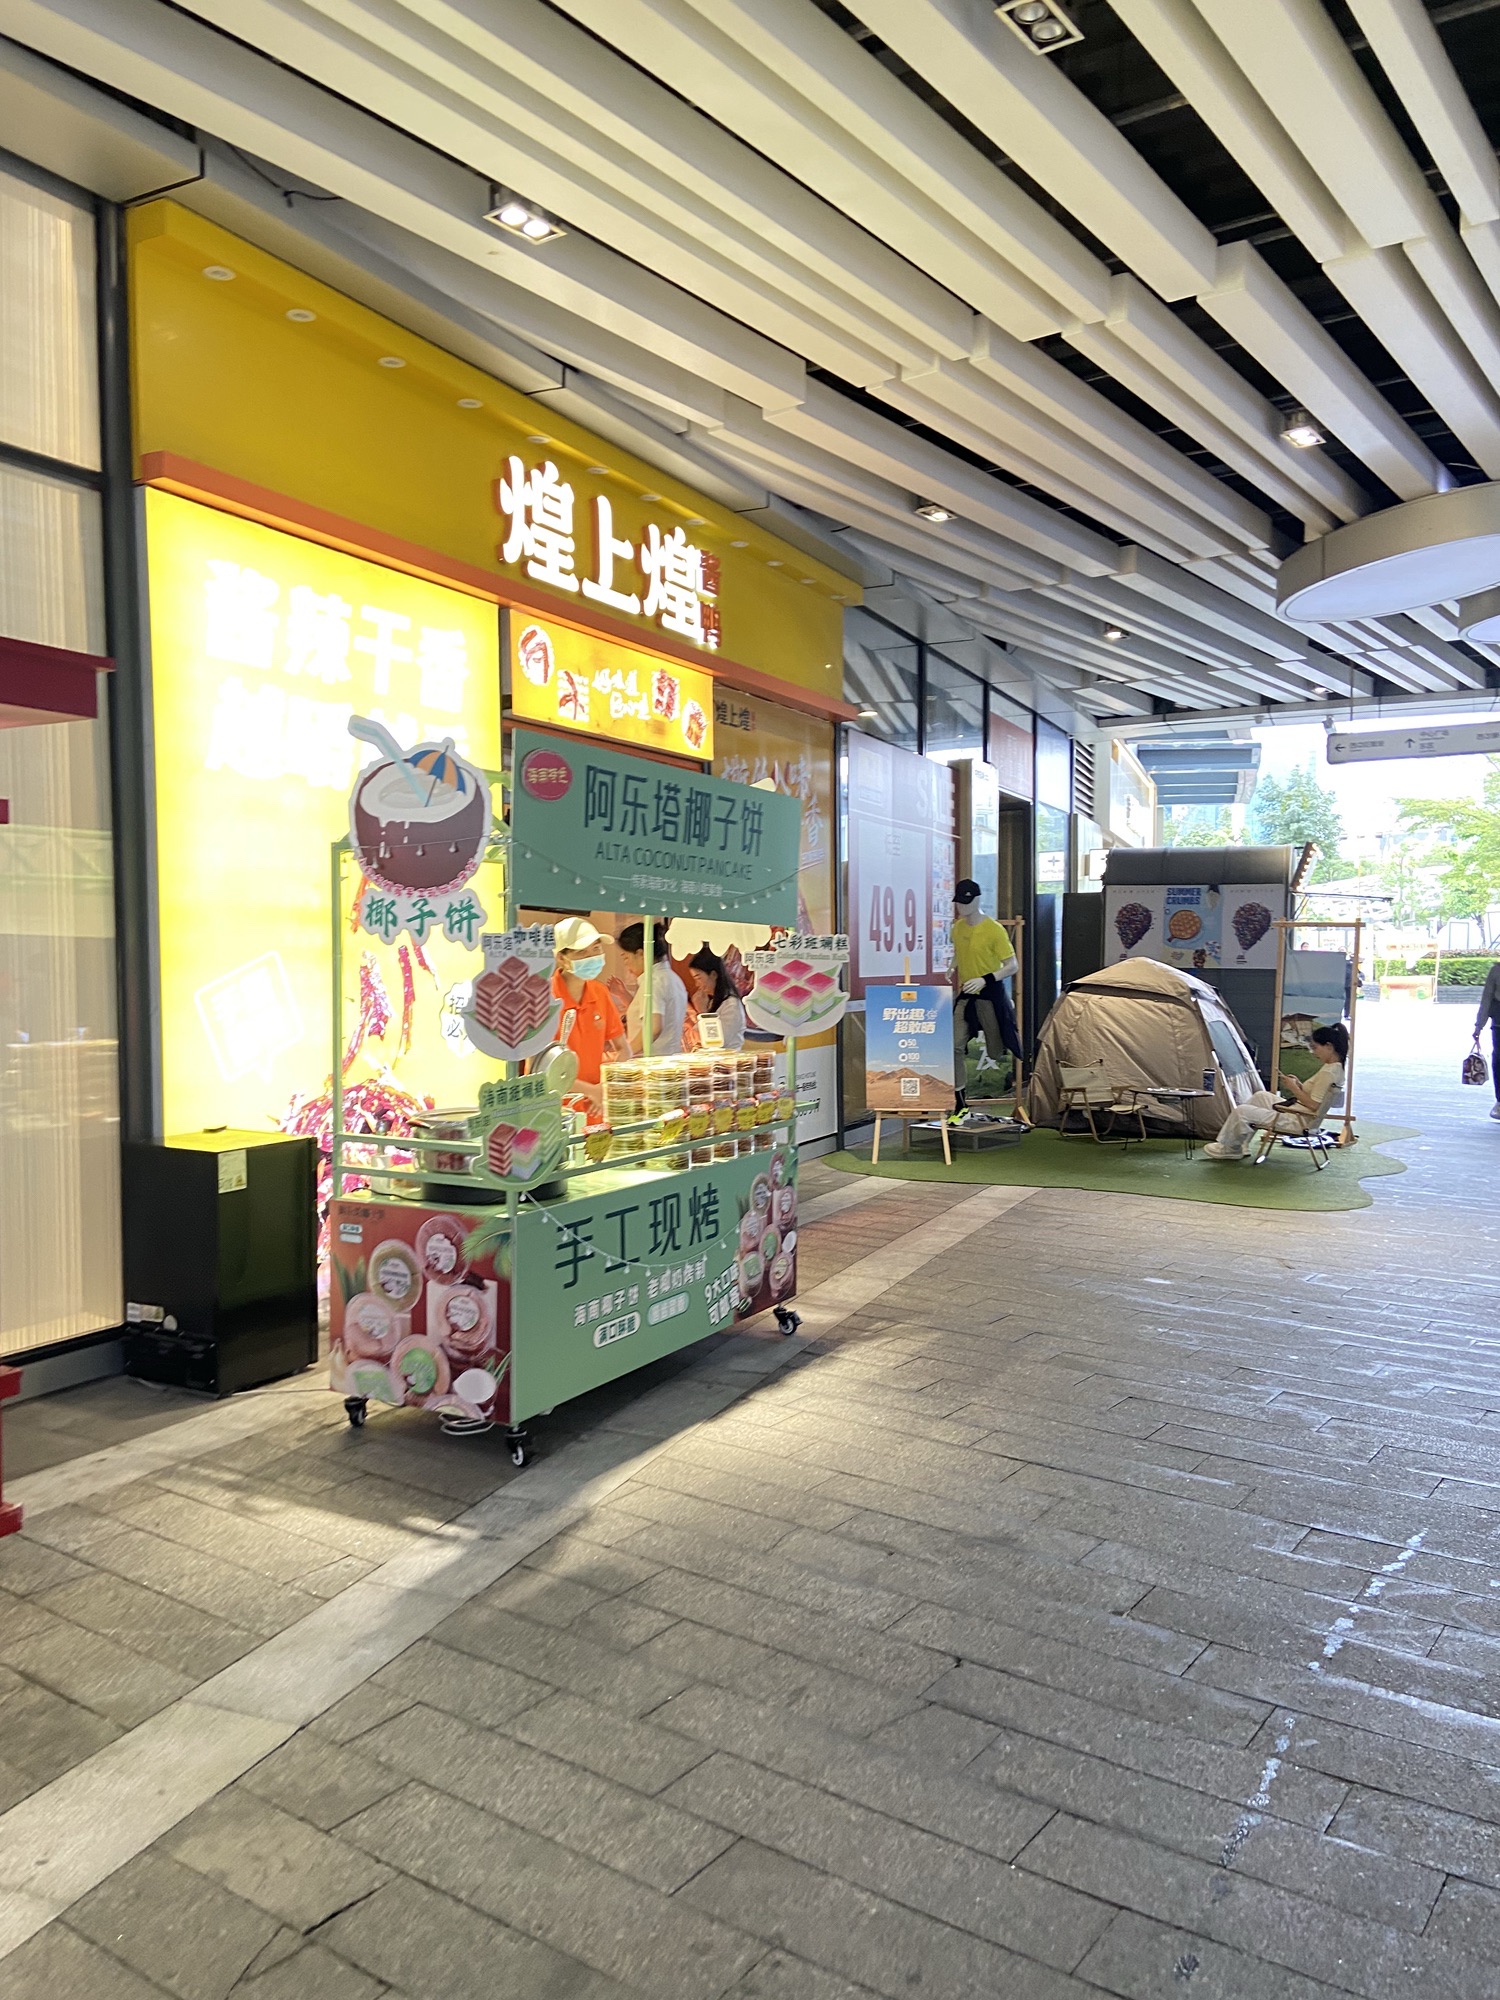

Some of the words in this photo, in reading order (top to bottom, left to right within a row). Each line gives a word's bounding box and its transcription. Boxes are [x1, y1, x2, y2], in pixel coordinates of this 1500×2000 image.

[499, 455, 702, 645] 煌上煌
[584, 764, 763, 856] 阿乐塔椰子饼
[595, 841, 630, 863] ALTA
[633, 847, 697, 871] COCONUT
[697, 857, 753, 880] PANCAKE
[365, 895, 481, 943] 椰子饼
[882, 1007, 925, 1020] 野出趣
[893, 1021, 936, 1034] 超敢晒
[555, 1183, 720, 1290] 手工现烤
[574, 1283, 639, 1328] 海南椰子饼
